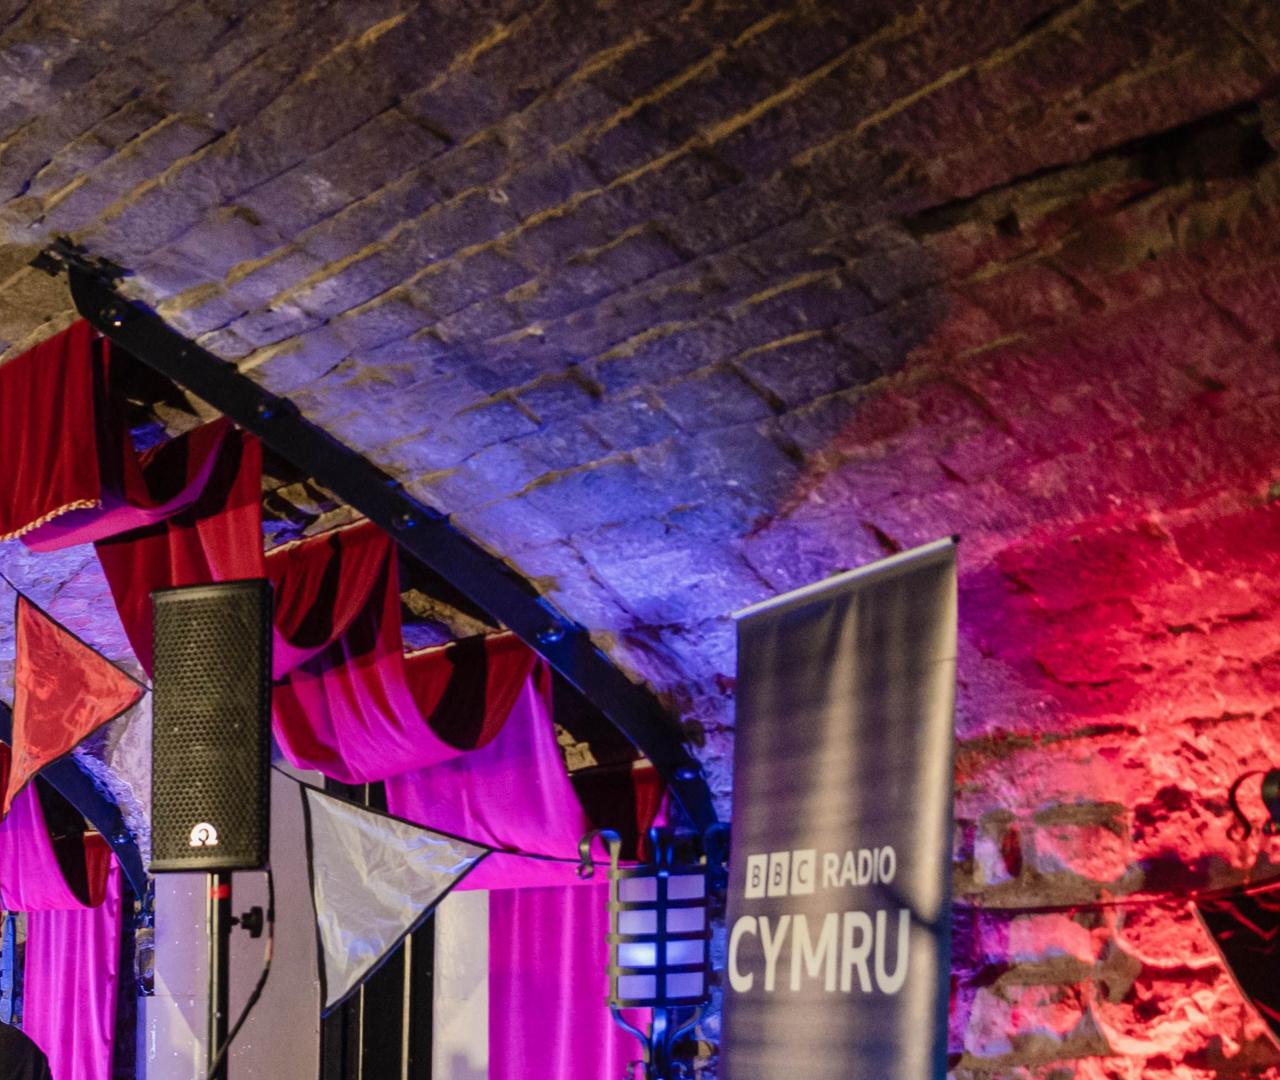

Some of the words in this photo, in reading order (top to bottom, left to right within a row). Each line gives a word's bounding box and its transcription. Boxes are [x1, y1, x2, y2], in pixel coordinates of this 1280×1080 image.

[746, 850, 815, 896] BBC
[822, 846, 896, 888] RADIO
[728, 909, 910, 994] CYMRU
